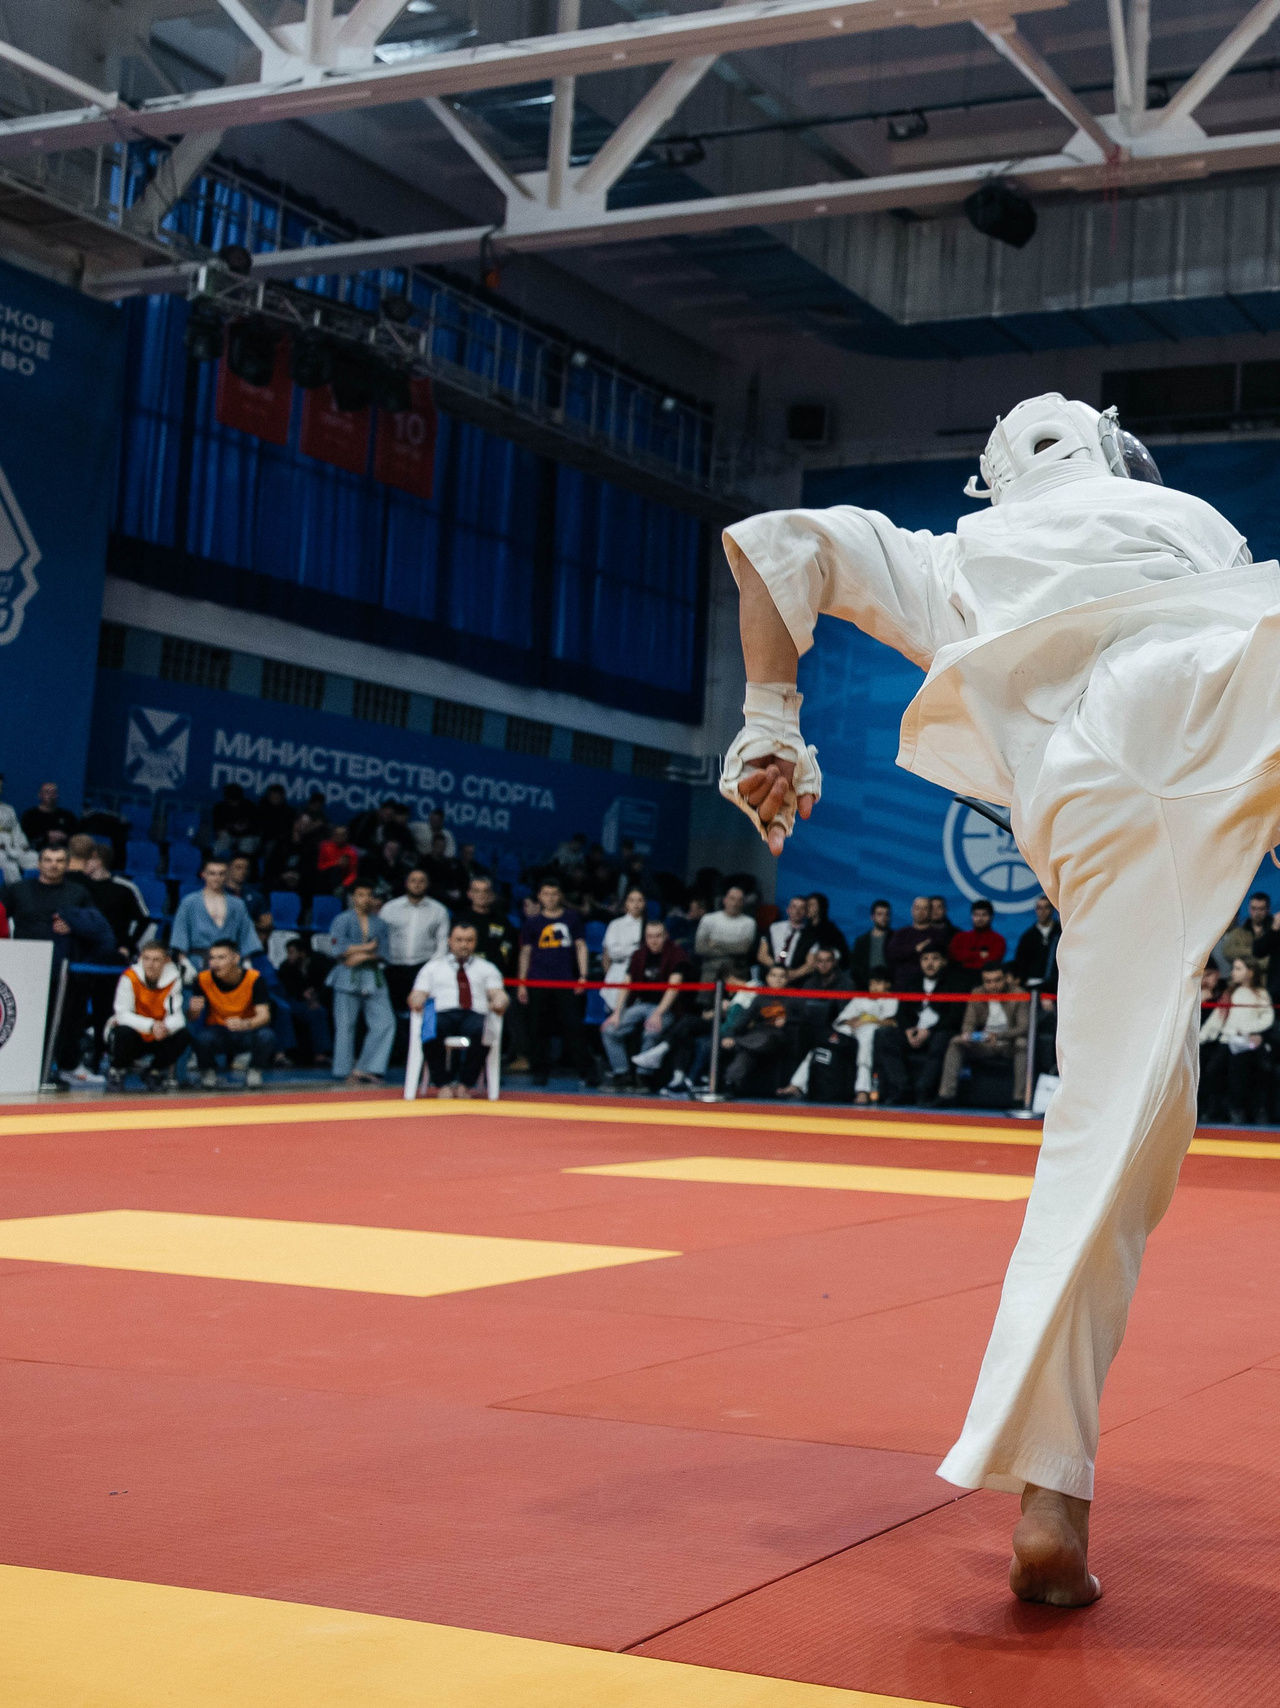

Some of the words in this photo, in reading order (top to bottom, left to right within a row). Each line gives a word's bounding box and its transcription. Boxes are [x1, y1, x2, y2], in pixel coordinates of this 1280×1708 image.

[0, 303, 55, 340] КОЕ
[213, 728, 455, 794] МИНИСТЕРСТВО
[462, 774, 557, 812] СПОРТА
[443, 800, 510, 832] КРАЯ
